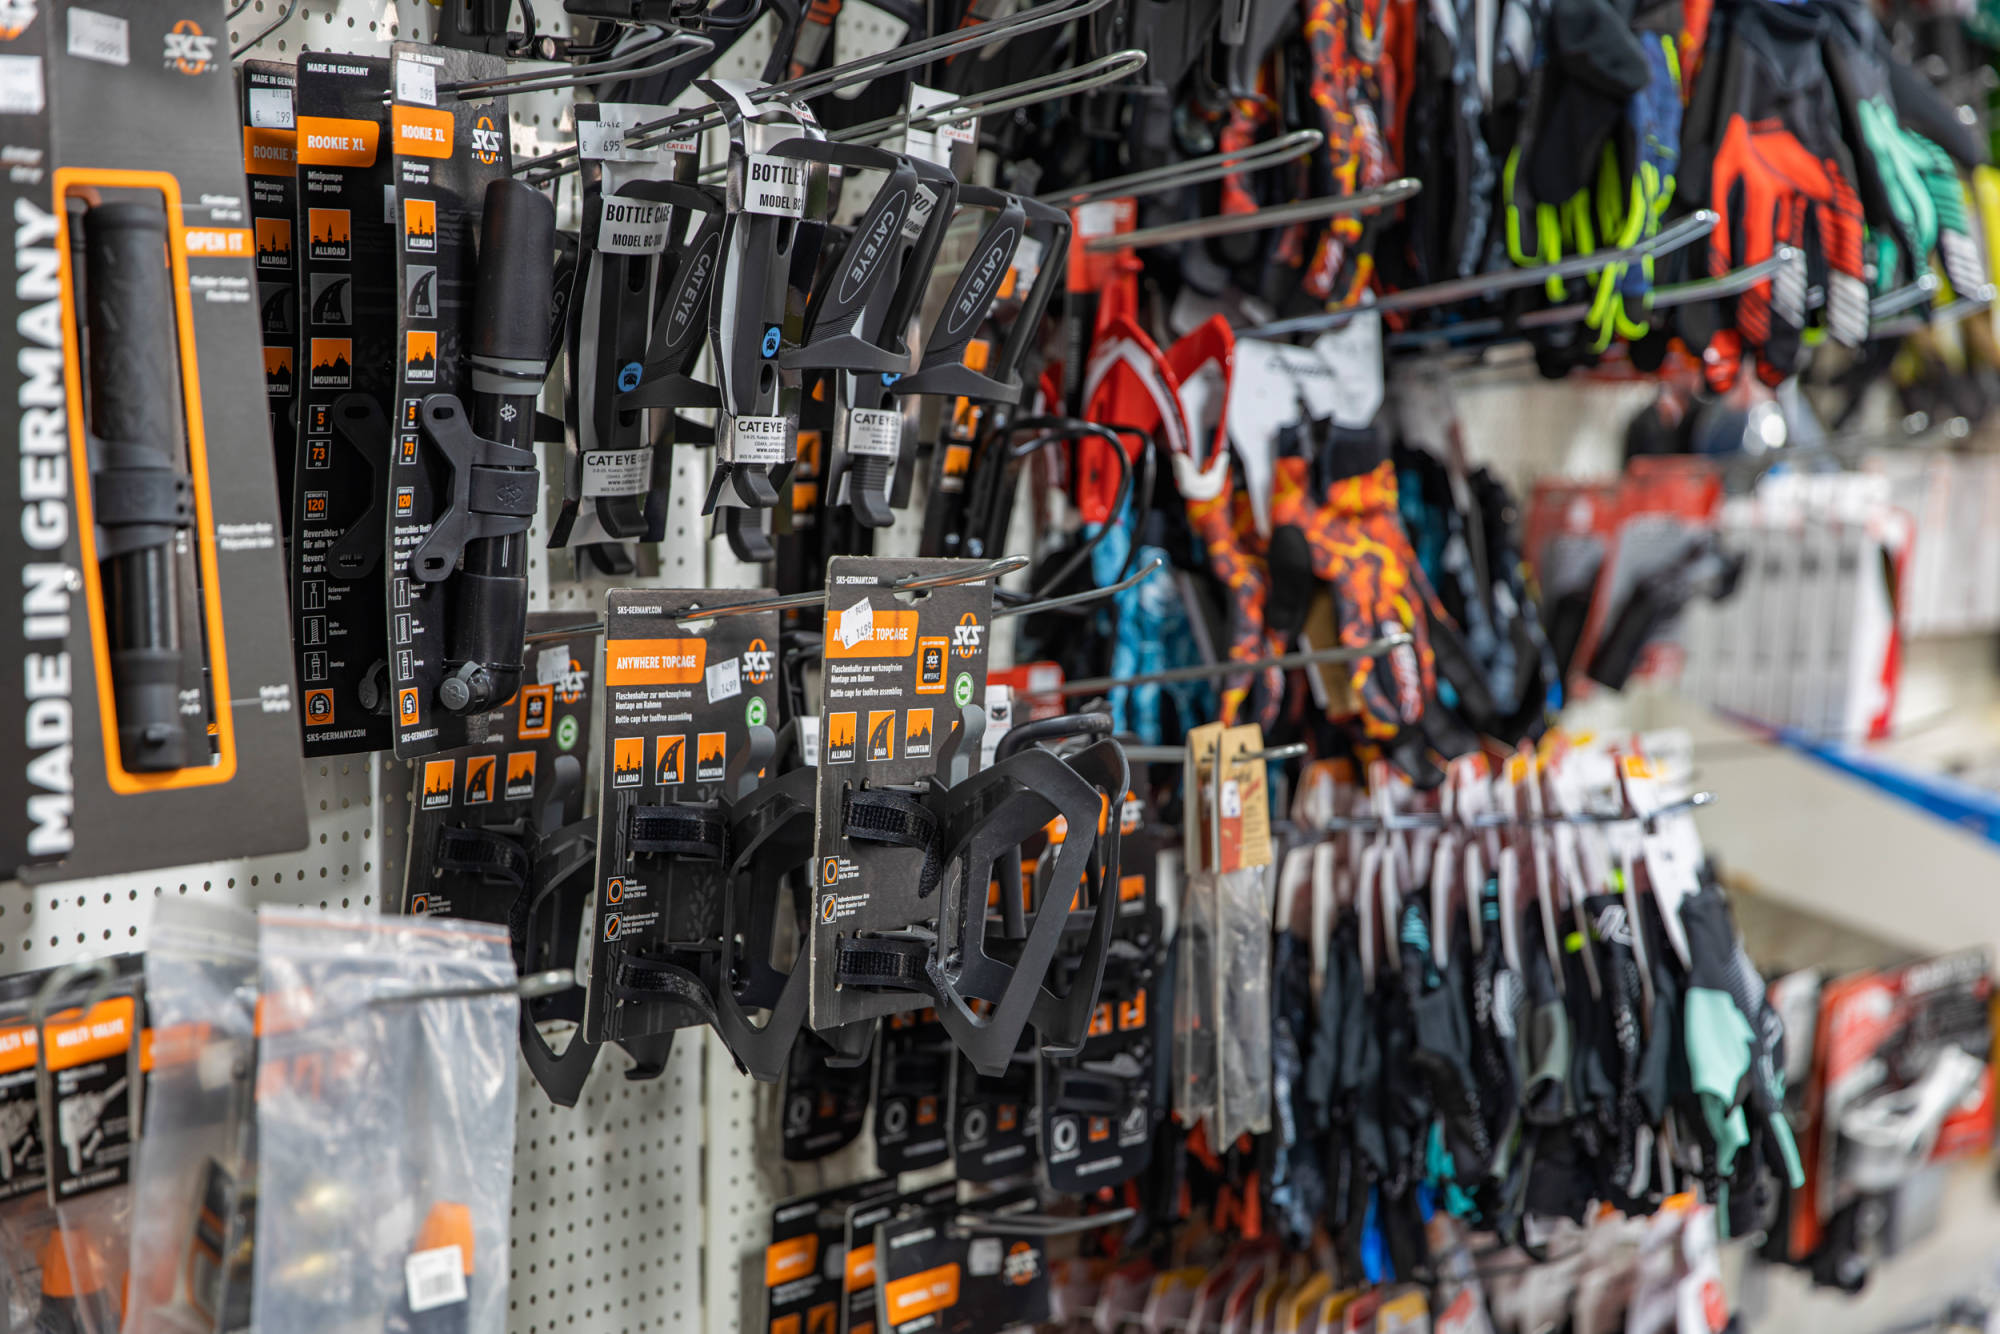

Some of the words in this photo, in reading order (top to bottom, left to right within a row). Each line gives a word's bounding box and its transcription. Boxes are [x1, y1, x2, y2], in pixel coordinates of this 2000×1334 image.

[163, 33, 218, 61] SKS
[307, 62, 327, 73] MADE
[328, 64, 337, 74] IN
[337, 65, 369, 77] GERMANY
[251, 74, 269, 84] MADE
[277, 77, 296, 87] GERMA
[401, 124, 433, 141] ROOKIE
[434, 128, 446, 142] XL
[472, 128, 500, 152] SKS
[307, 134, 349, 150] ROOKIE
[352, 138, 366, 152] XL
[582, 140, 588, 152] €
[603, 140, 620, 152] 695
[253, 145, 288, 161] ROOKIE
[291, 148, 297, 160] X
[307, 170, 344, 182] Minipumpe
[752, 162, 799, 186] BOTTLE
[308, 182, 323, 191] Mini
[323, 184, 342, 194] pump
[759, 193, 791, 210] MODEL
[911, 192, 934, 216] BOT
[605, 203, 653, 224] BOTTLE
[186, 231, 226, 252] OPEN
[228, 232, 243, 252] IT
[409, 238, 433, 248] ALLROAD
[612, 233, 642, 247] MODEL
[850, 210, 895, 284] CATEYE
[315, 246, 346, 256] ALLROAD
[261, 255, 288, 265] ALLROAD
[959, 246, 1003, 315] CATEYE
[675, 253, 711, 327] CATEYE
[322, 311, 341, 320] ROAD
[415, 304, 429, 313] ROAD
[14, 197, 70, 549] GERMANY
[313, 375, 349, 385] MOUNTAIN
[408, 369, 434, 378] MOUNTAIN
[266, 383, 289, 393] UNTAIN
[317, 412, 325, 425] 5
[408, 406, 416, 420] 5
[738, 421, 783, 433] CATEYE
[312, 447, 326, 460] 73
[403, 442, 415, 456] 73
[587, 454, 637, 466] CATEYE
[307, 498, 325, 512] 120
[398, 494, 411, 508] 120
[303, 529, 338, 538] Reversibles
[303, 540, 313, 549] für
[303, 564, 312, 573] for
[313, 564, 322, 573] all
[836, 575, 879, 585] SKS-GERMANY.COM
[22, 561, 71, 641] IN
[617, 605, 663, 615] SKS-GERMANY.COM
[876, 627, 909, 641] TOPCAGE
[952, 625, 982, 646] SKS
[616, 655, 660, 670] ANYWHERE
[661, 655, 696, 669] TOPCAGE
[742, 651, 773, 672] SKS
[315, 700, 325, 714] 5
[406, 700, 413, 714] 5
[306, 728, 367, 743] SKS-GERMANY.COM
[23, 650, 75, 856] MADE
[831, 749, 852, 760] ALLROAD
[874, 747, 887, 757] ROAD
[906, 744, 930, 754] MOUNTAIN
[617, 773, 640, 784] ALLROAD
[663, 771, 677, 780] ROAD
[698, 767, 723, 777] MOUNTAIN
[426, 794, 449, 806] ALLROAD
